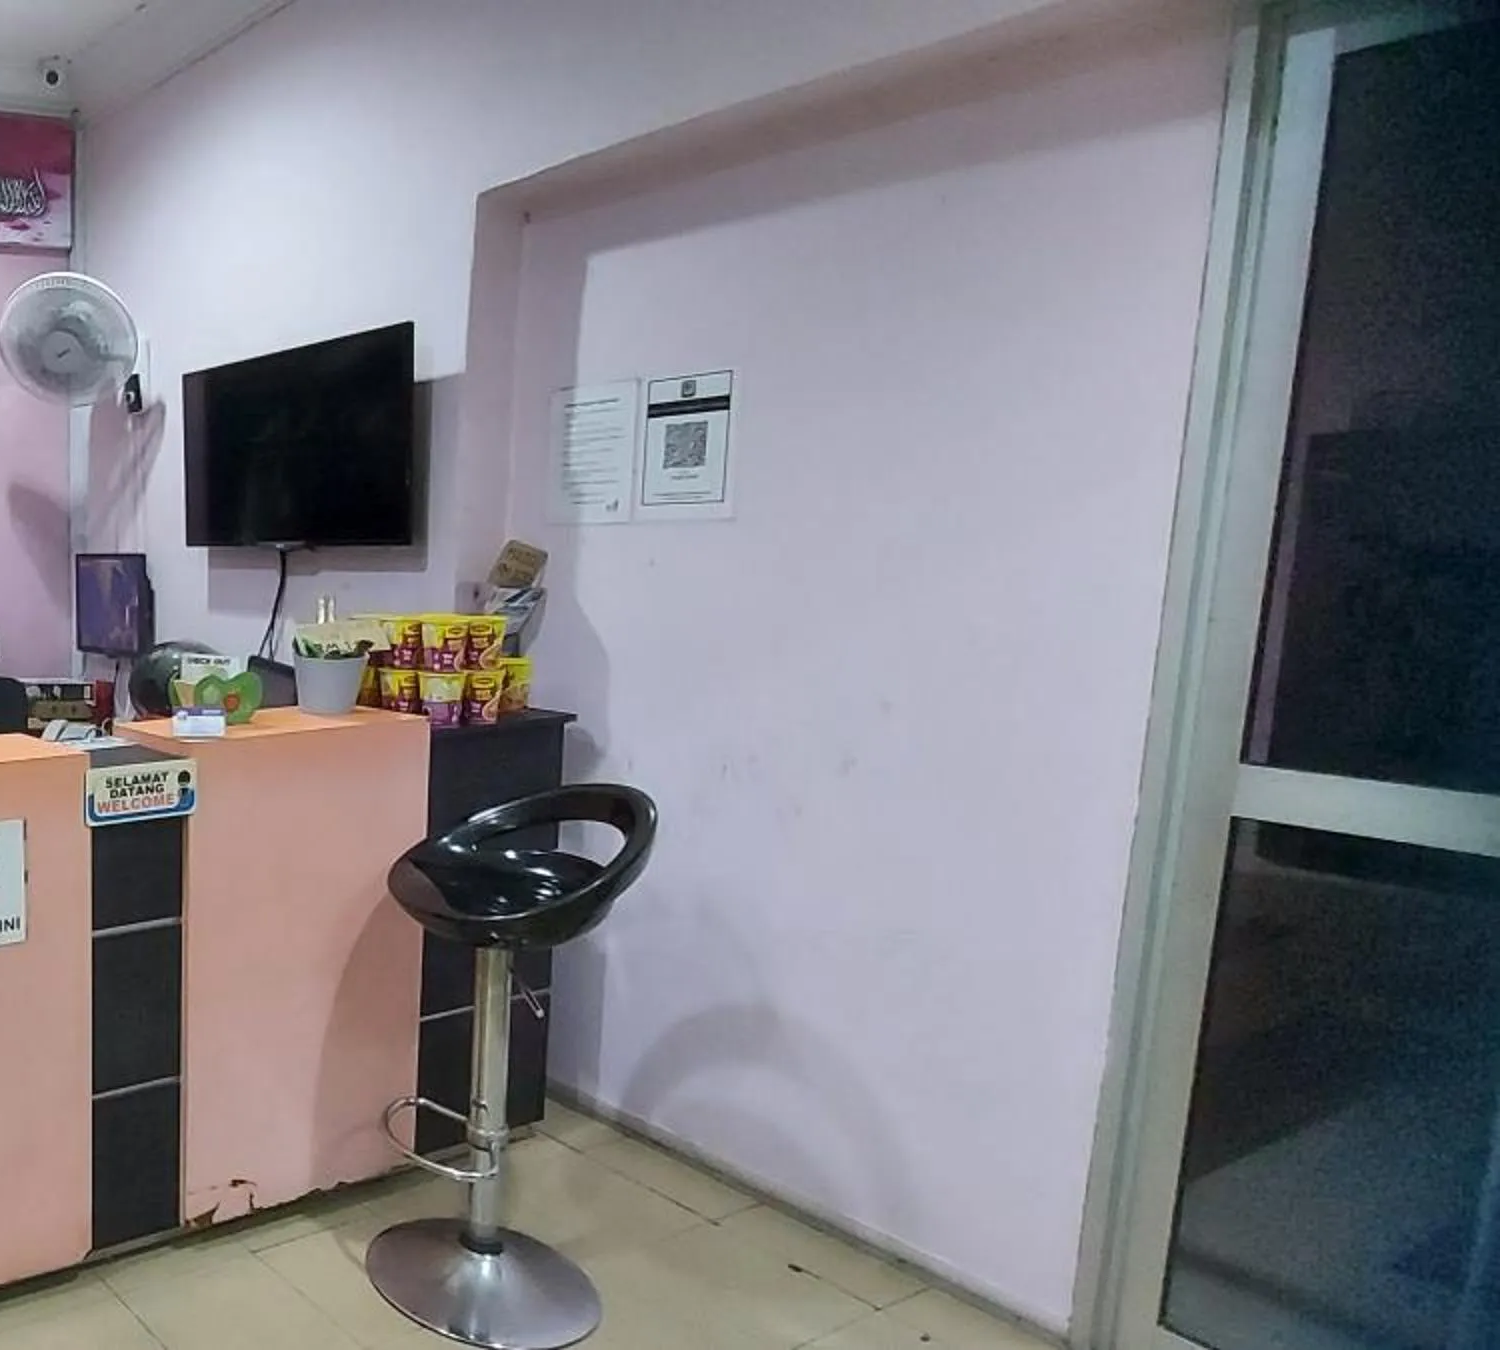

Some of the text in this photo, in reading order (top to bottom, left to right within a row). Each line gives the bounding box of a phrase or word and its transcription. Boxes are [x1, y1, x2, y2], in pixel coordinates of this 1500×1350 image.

[105, 770, 170, 789] SELAMAT
[109, 784, 165, 799] DATANG
[98, 792, 176, 813] WELCOME
